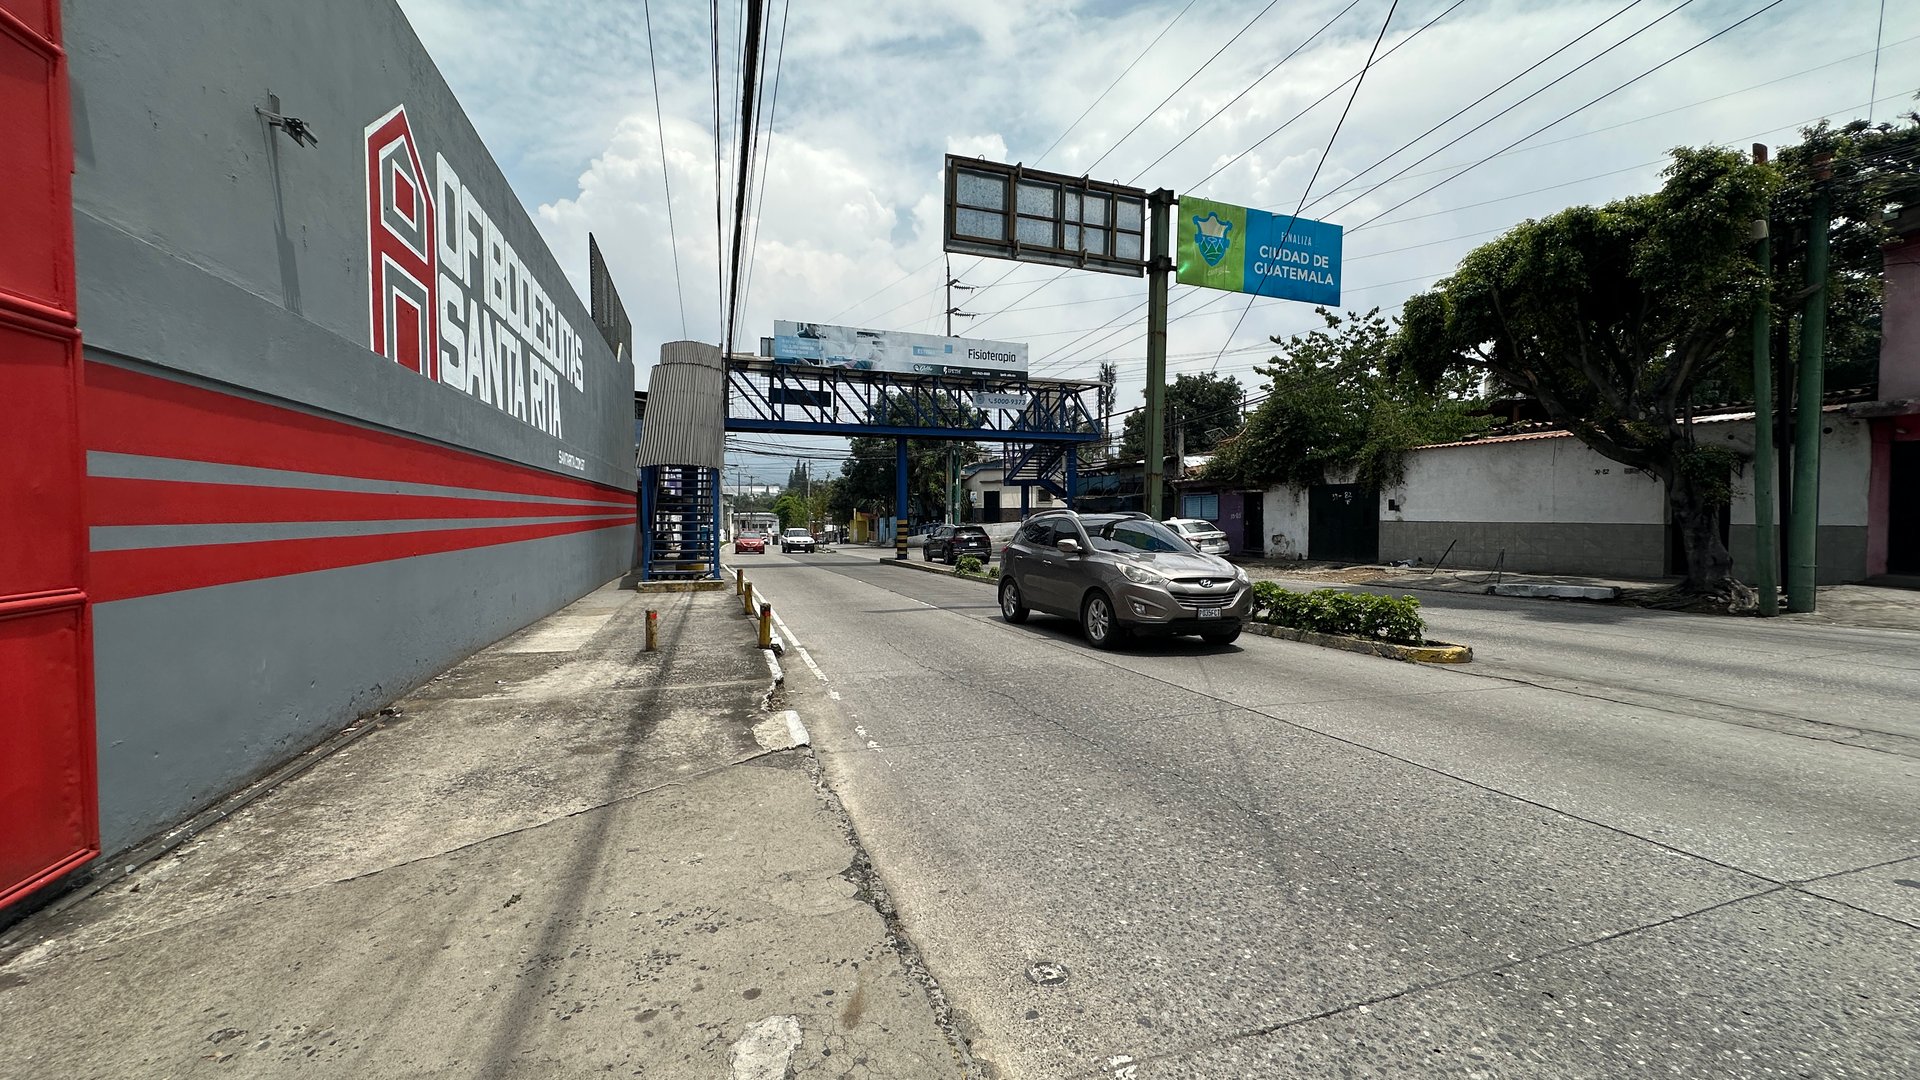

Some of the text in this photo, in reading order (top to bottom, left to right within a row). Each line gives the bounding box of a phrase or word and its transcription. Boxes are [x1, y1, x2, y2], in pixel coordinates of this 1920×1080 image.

[1281, 232, 1312, 246] FINALIZA
[1259, 245, 1329, 268] CIUDAD DE
[436, 152, 584, 393] OFIBODEGUITAS
[1254, 262, 1334, 286] GUATEMALA
[439, 272, 563, 439] SANTA RITA
[968, 348, 1016, 364] Fisioterapia
